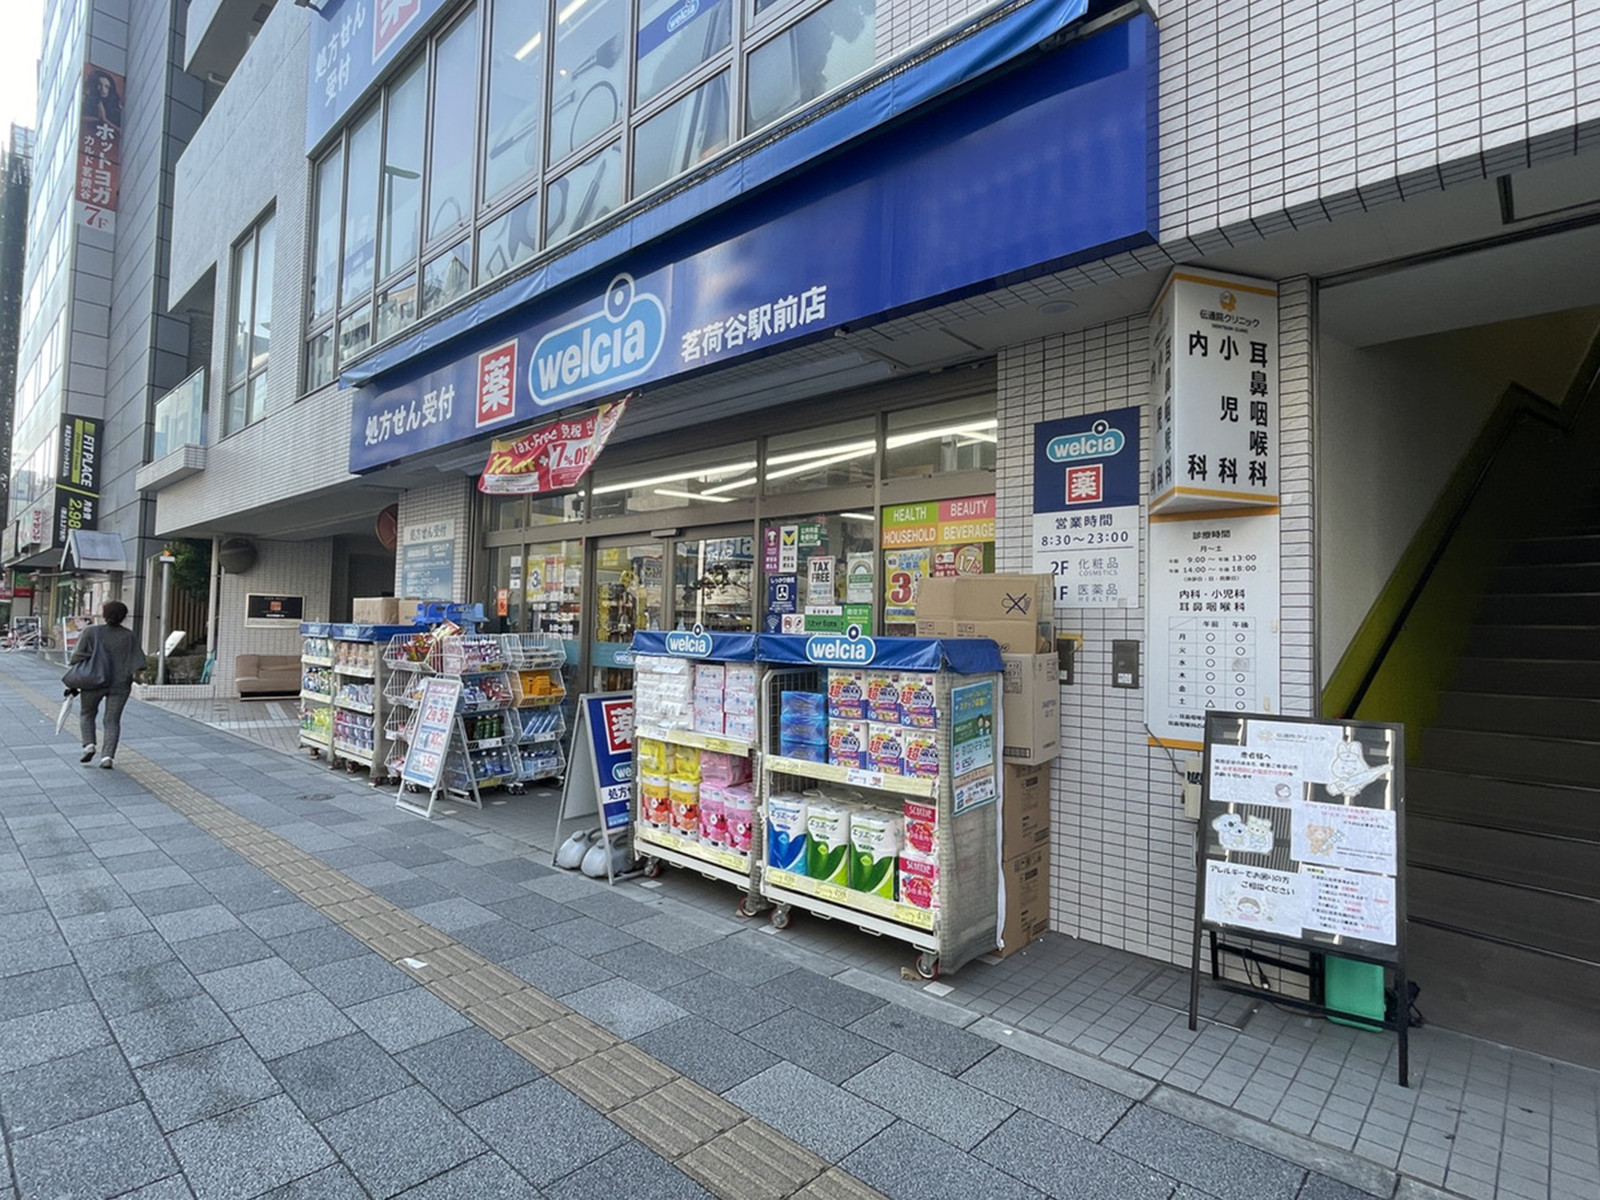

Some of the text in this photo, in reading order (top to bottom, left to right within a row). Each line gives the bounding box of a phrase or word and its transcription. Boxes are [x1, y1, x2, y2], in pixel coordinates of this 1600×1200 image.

[325, 53, 351, 107] 受付
[93, 123, 115, 205] ホットヨガ
[681, 285, 827, 362] 茗荷谷駅前店
[537, 319, 646, 393] welcia
[480, 355, 511, 413] 薬
[365, 383, 455, 446] 処方せん受付
[1249, 341, 1268, 487] 耳鼻咽喉科
[1054, 436, 1116, 458] welcia
[80, 451, 94, 488] PLACE
[1071, 470, 1097, 499] 薬
[893, 506, 927, 522] HEALTH
[950, 500, 988, 517] BEAUTY
[1055, 513, 1113, 530] 営業時間
[884, 527, 936, 544] HOUSEHOLD
[943, 523, 995, 540] BEVERAGE
[812, 561, 829, 572] TAX
[1050, 556, 1118, 576] 2F 化粧品
[1079, 569, 1118, 577] COSMETICS
[532, 569, 541, 588] 3
[812, 572, 830, 582] FREE
[890, 572, 913, 604] 3
[1077, 583, 1118, 596] 医薬品
[1179, 589, 1246, 600] 内科・小児科
[1179, 602, 1246, 612] 耳鼻咽喉科
[669, 636, 706, 653] welcia
[1178, 633, 1186, 641] 月
[812, 641, 866, 660] welcia
[852, 828, 885, 842] エリエール
